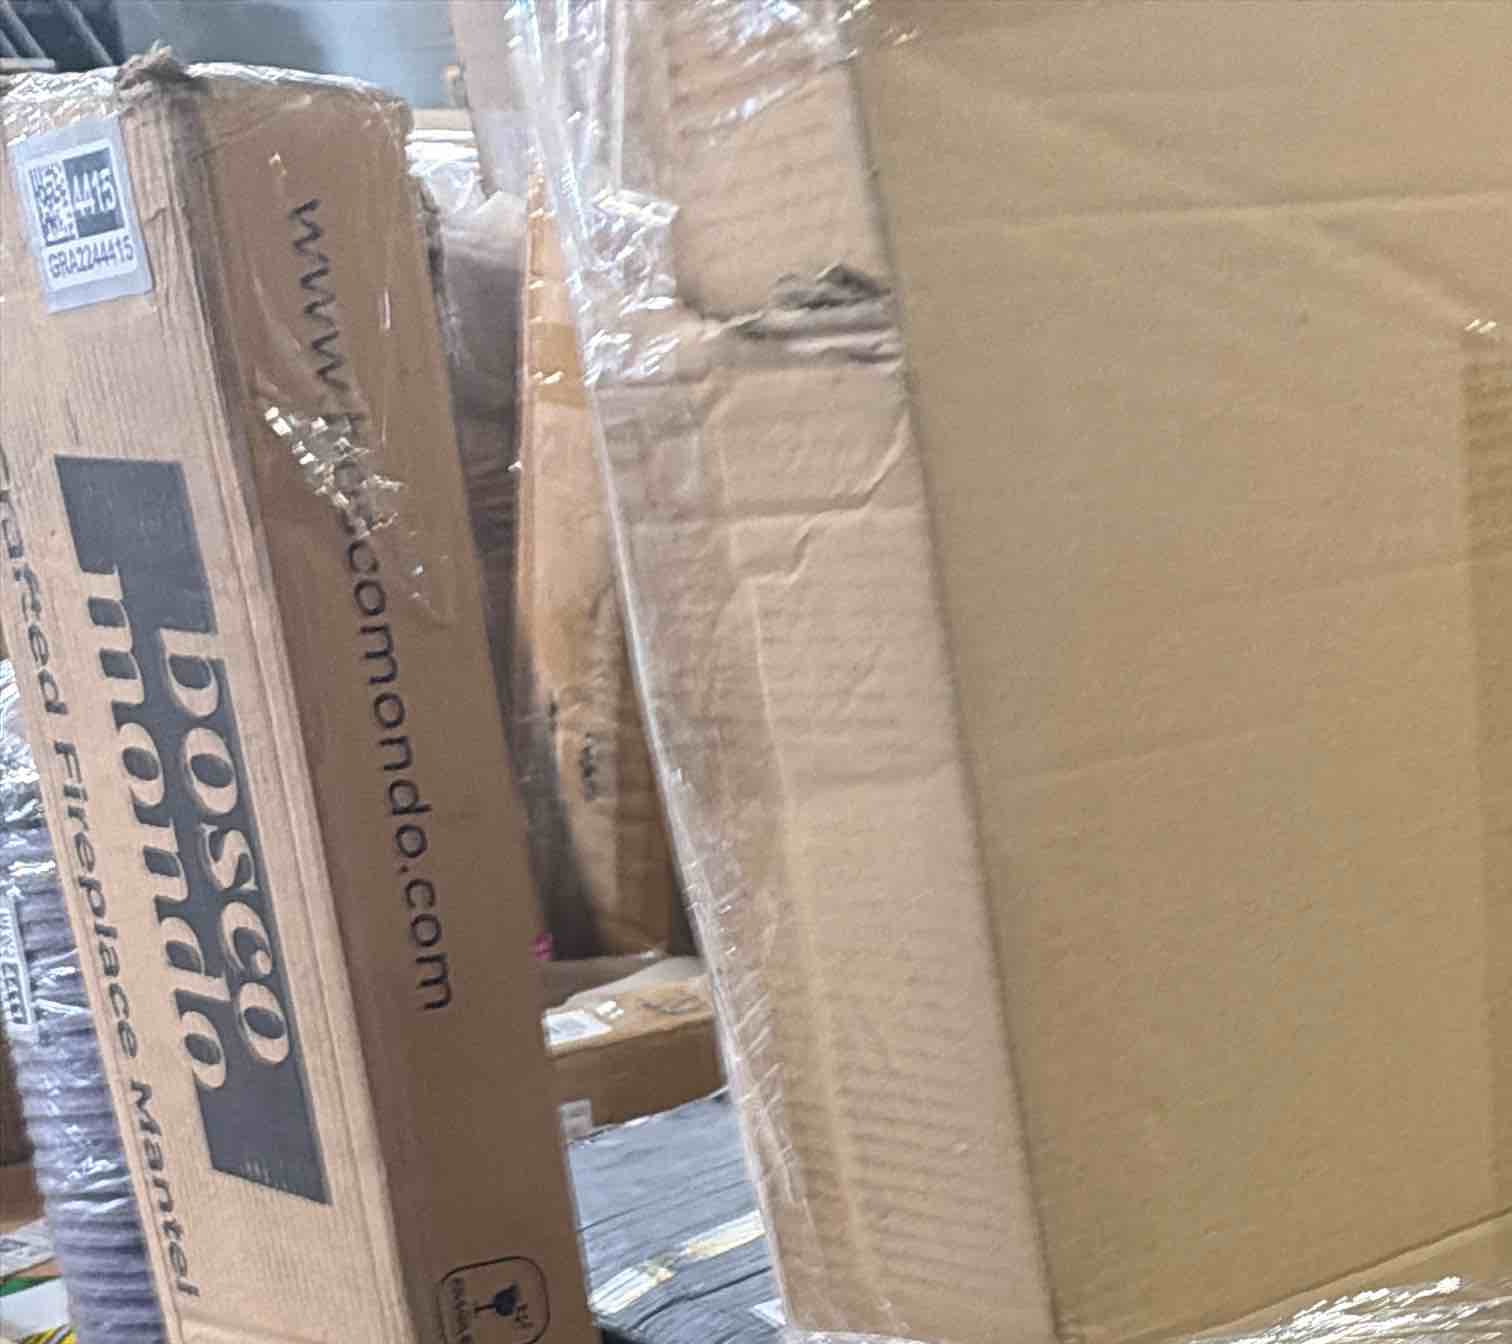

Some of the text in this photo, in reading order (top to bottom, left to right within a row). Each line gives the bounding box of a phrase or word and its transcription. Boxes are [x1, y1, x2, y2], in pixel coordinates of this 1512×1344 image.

[53, 740, 138, 1061] Fireplace
[127, 1080, 200, 1298] Mantel
[86, 563, 229, 1090] mondo
[153, 626, 292, 1067] bosco
